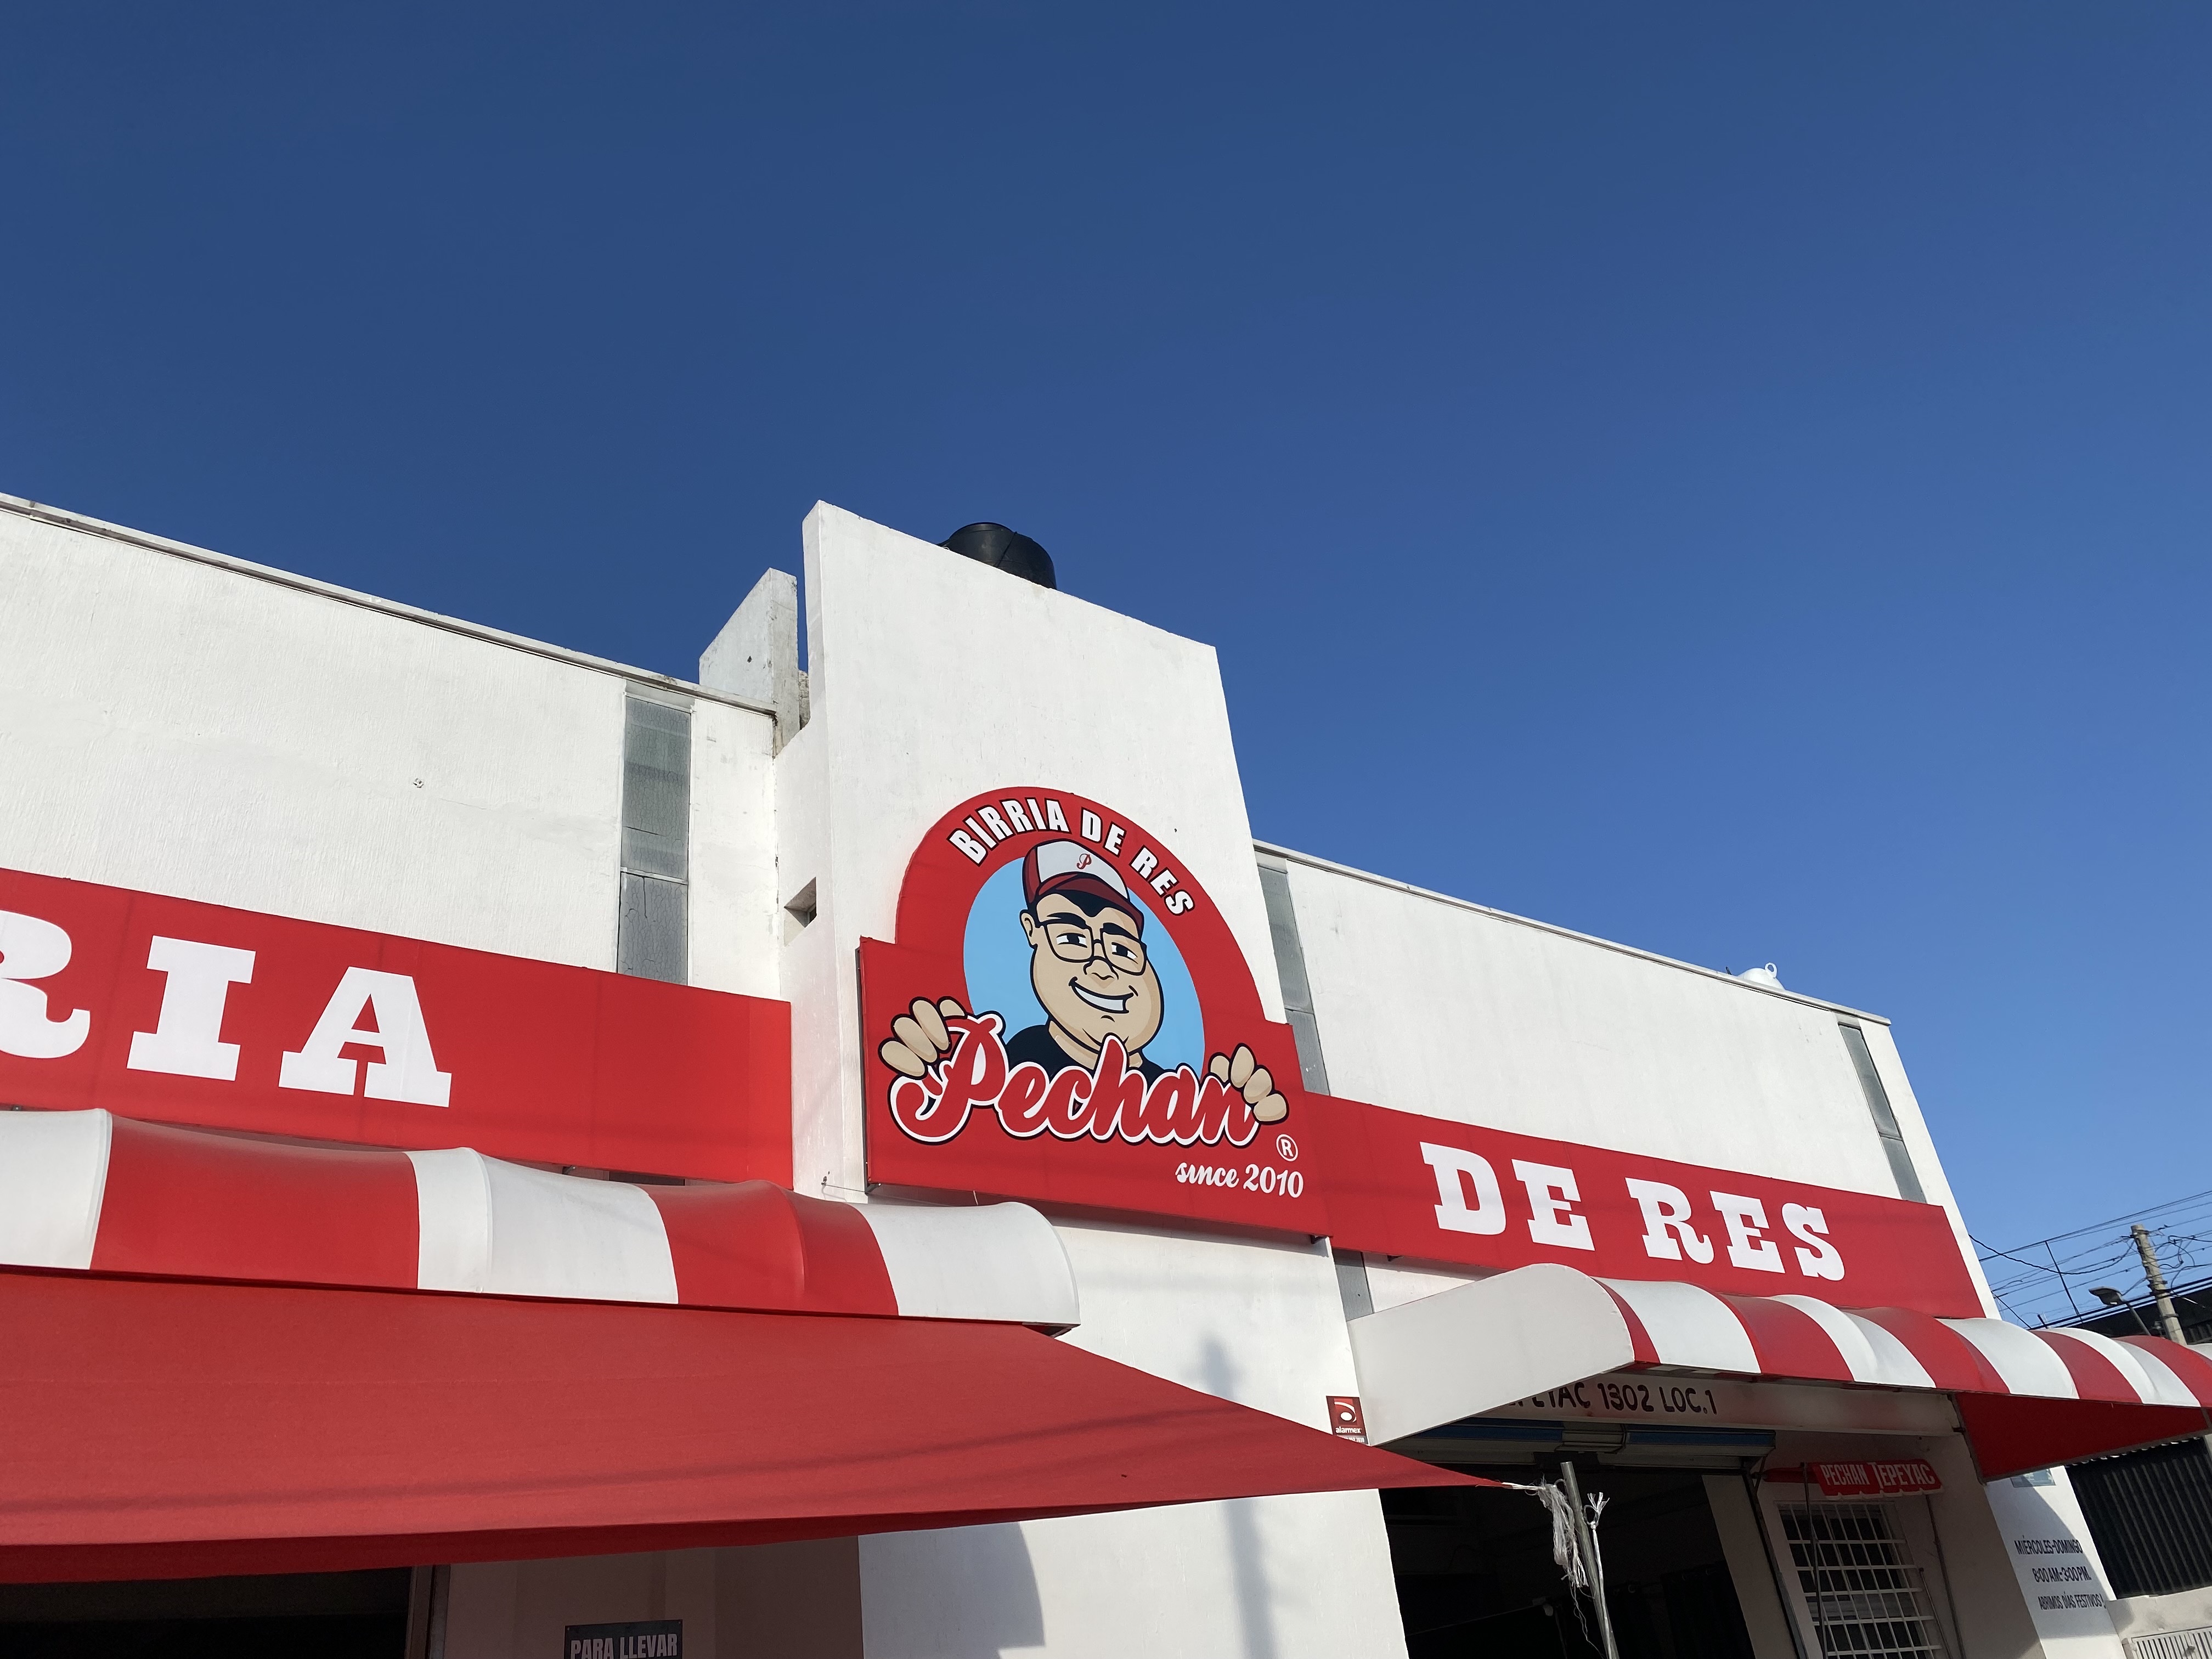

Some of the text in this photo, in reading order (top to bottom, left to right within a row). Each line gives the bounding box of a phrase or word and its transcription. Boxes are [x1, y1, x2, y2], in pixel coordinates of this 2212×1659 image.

[949, 798, 1194, 915] BIRRIA DE RES
[890, 1013, 1262, 1147] Pechan
[1175, 1162, 1304, 1198] since 2010
[1420, 1141, 1846, 1282] DE RES
[1597, 1383, 1654, 1412] 1302
[1820, 1462, 1936, 1489] PECHAN TEPEYAC
[2038, 1595, 2063, 1610] ABRIMOS
[2062, 1591, 2076, 1609] DÍAS
[571, 1634, 678, 1659] PARA LLEVAR
